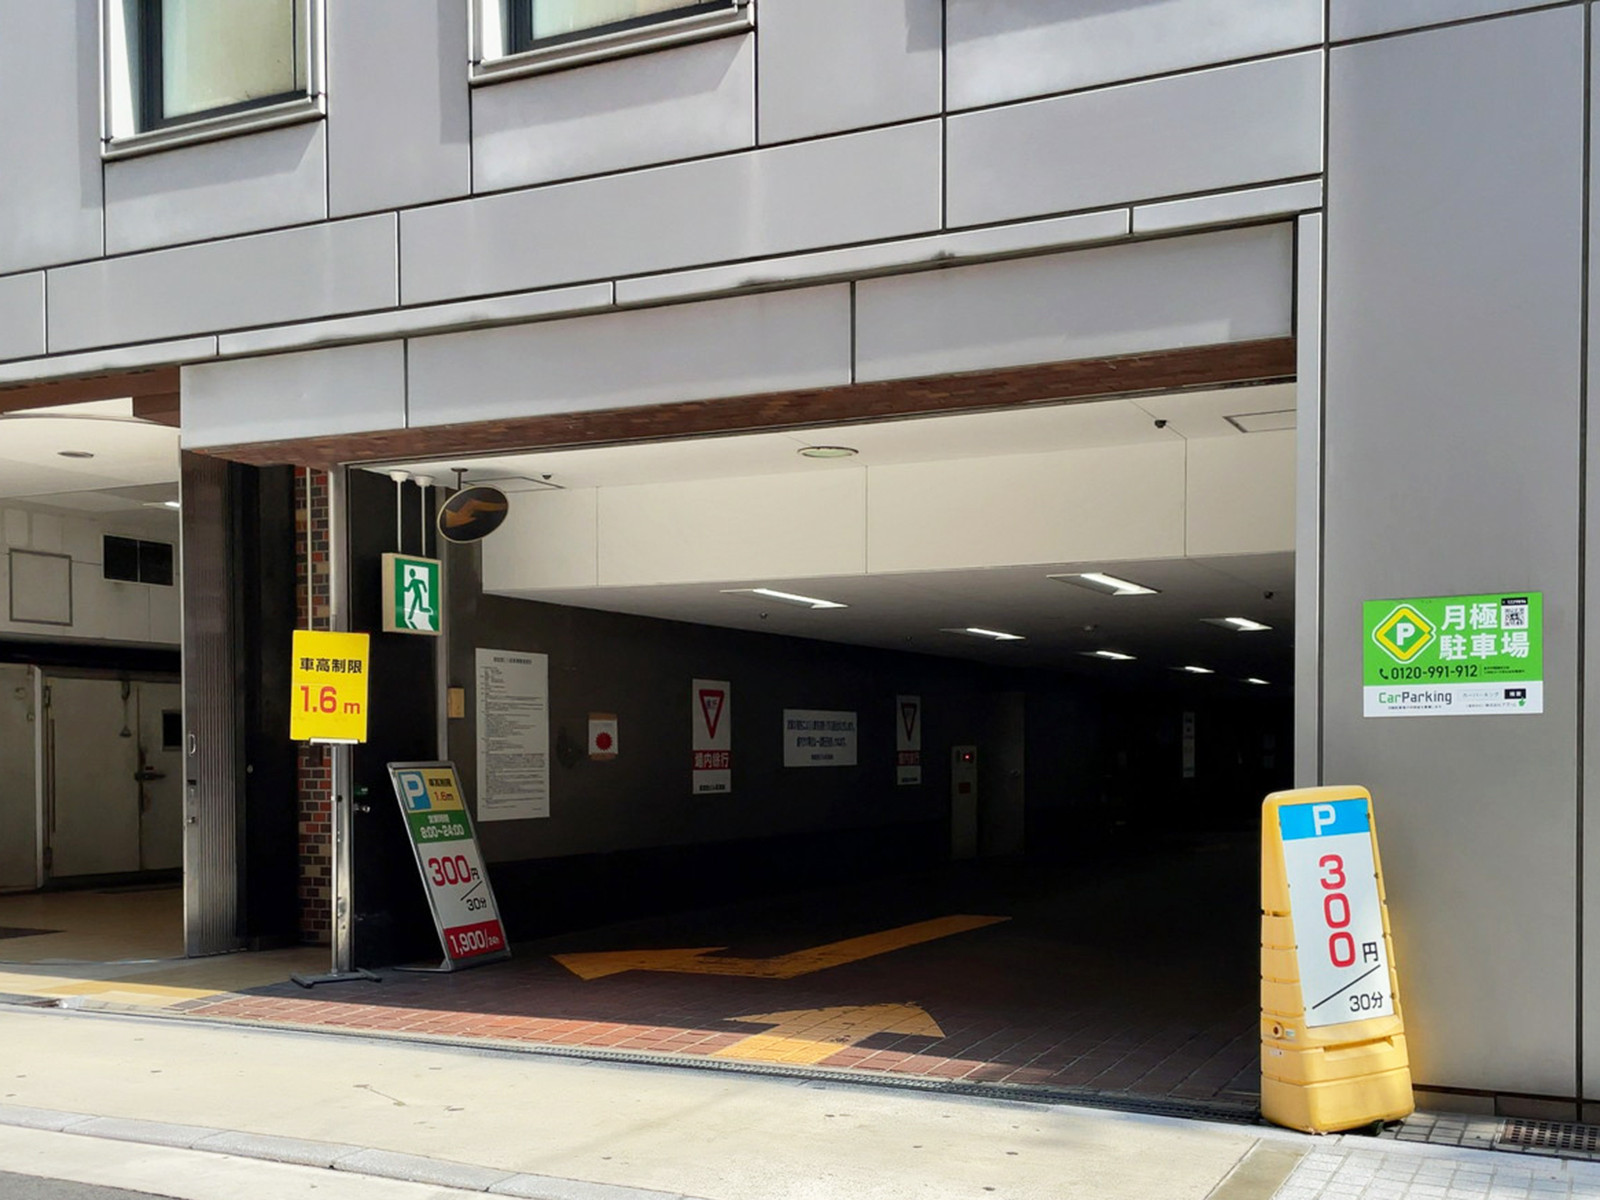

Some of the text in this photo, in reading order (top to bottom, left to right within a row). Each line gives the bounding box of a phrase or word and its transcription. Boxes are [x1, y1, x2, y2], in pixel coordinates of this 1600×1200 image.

[1440, 603, 1498, 631] 月極
[1396, 622, 1416, 646] P
[1439, 632, 1530, 661] 駐車場
[300, 656, 363, 674] 車高制限
[1391, 664, 1478, 680] 0120-991-912
[300, 685, 361, 715] 1.6 m
[1379, 690, 1452, 705] CarParking
[401, 773, 425, 809] P
[1312, 804, 1337, 836] P
[1318, 854, 1356, 968] 300
[1362, 941, 1380, 963] 円
[1349, 991, 1384, 1012] 30分
